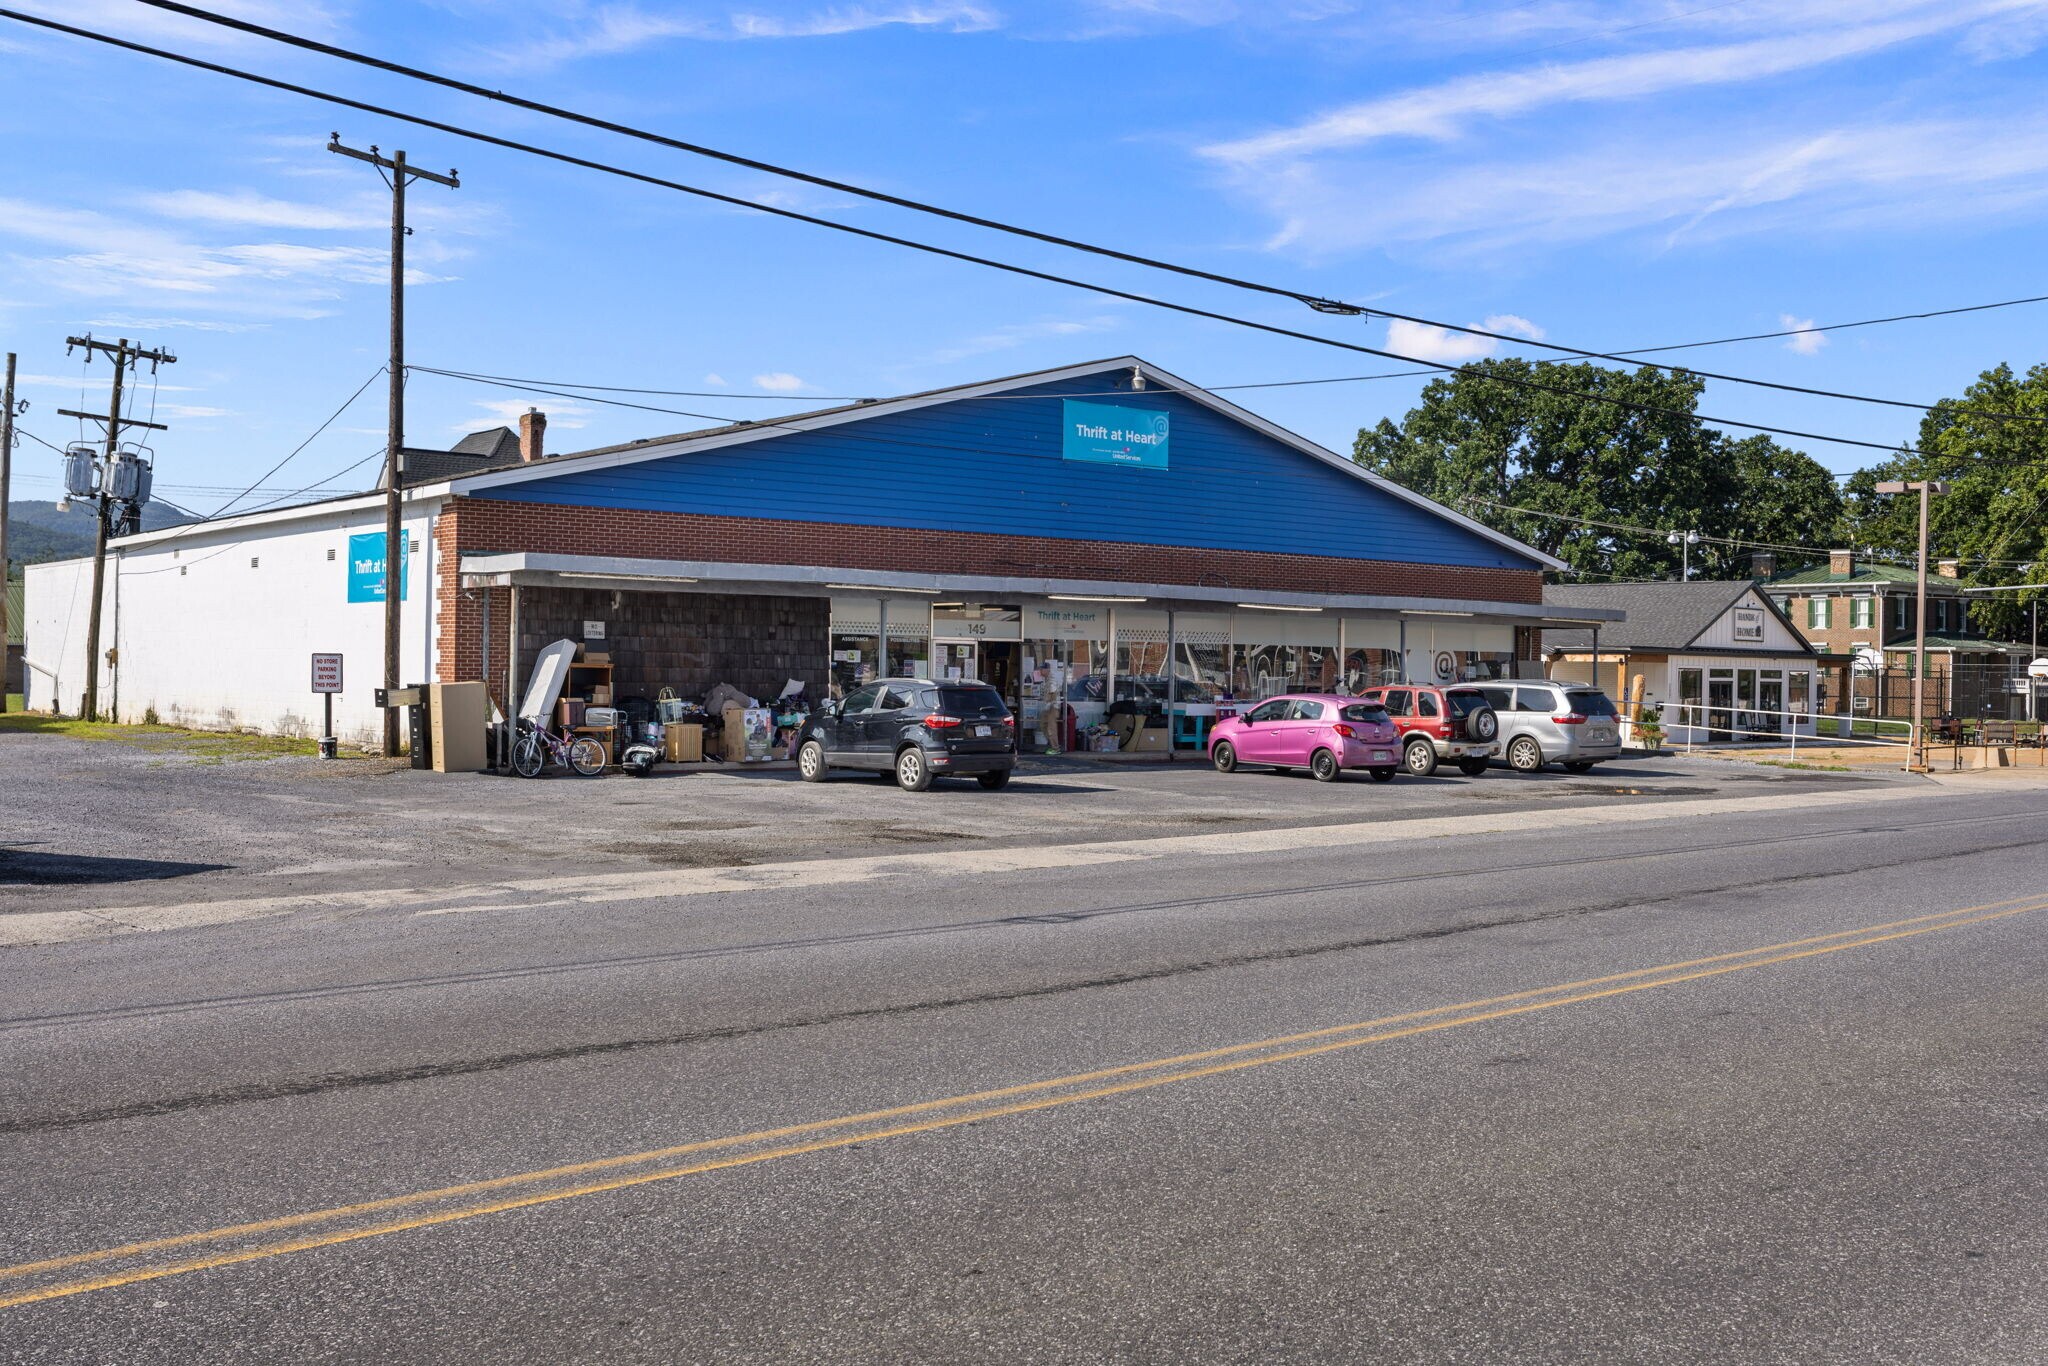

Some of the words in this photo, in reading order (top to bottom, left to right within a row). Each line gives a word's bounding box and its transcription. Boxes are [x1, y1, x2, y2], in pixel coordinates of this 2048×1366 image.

[1076, 423, 1108, 440] Thrift
[1111, 430, 1122, 442] at
[1126, 430, 1157, 445] Heart
[355, 559, 373, 575] Thrift
[374, 560, 380, 573] at
[1038, 610, 1060, 621] Thrift
[1062, 612, 1071, 621] at
[1073, 612, 1096, 622] Heart
[968, 624, 986, 634] 149
